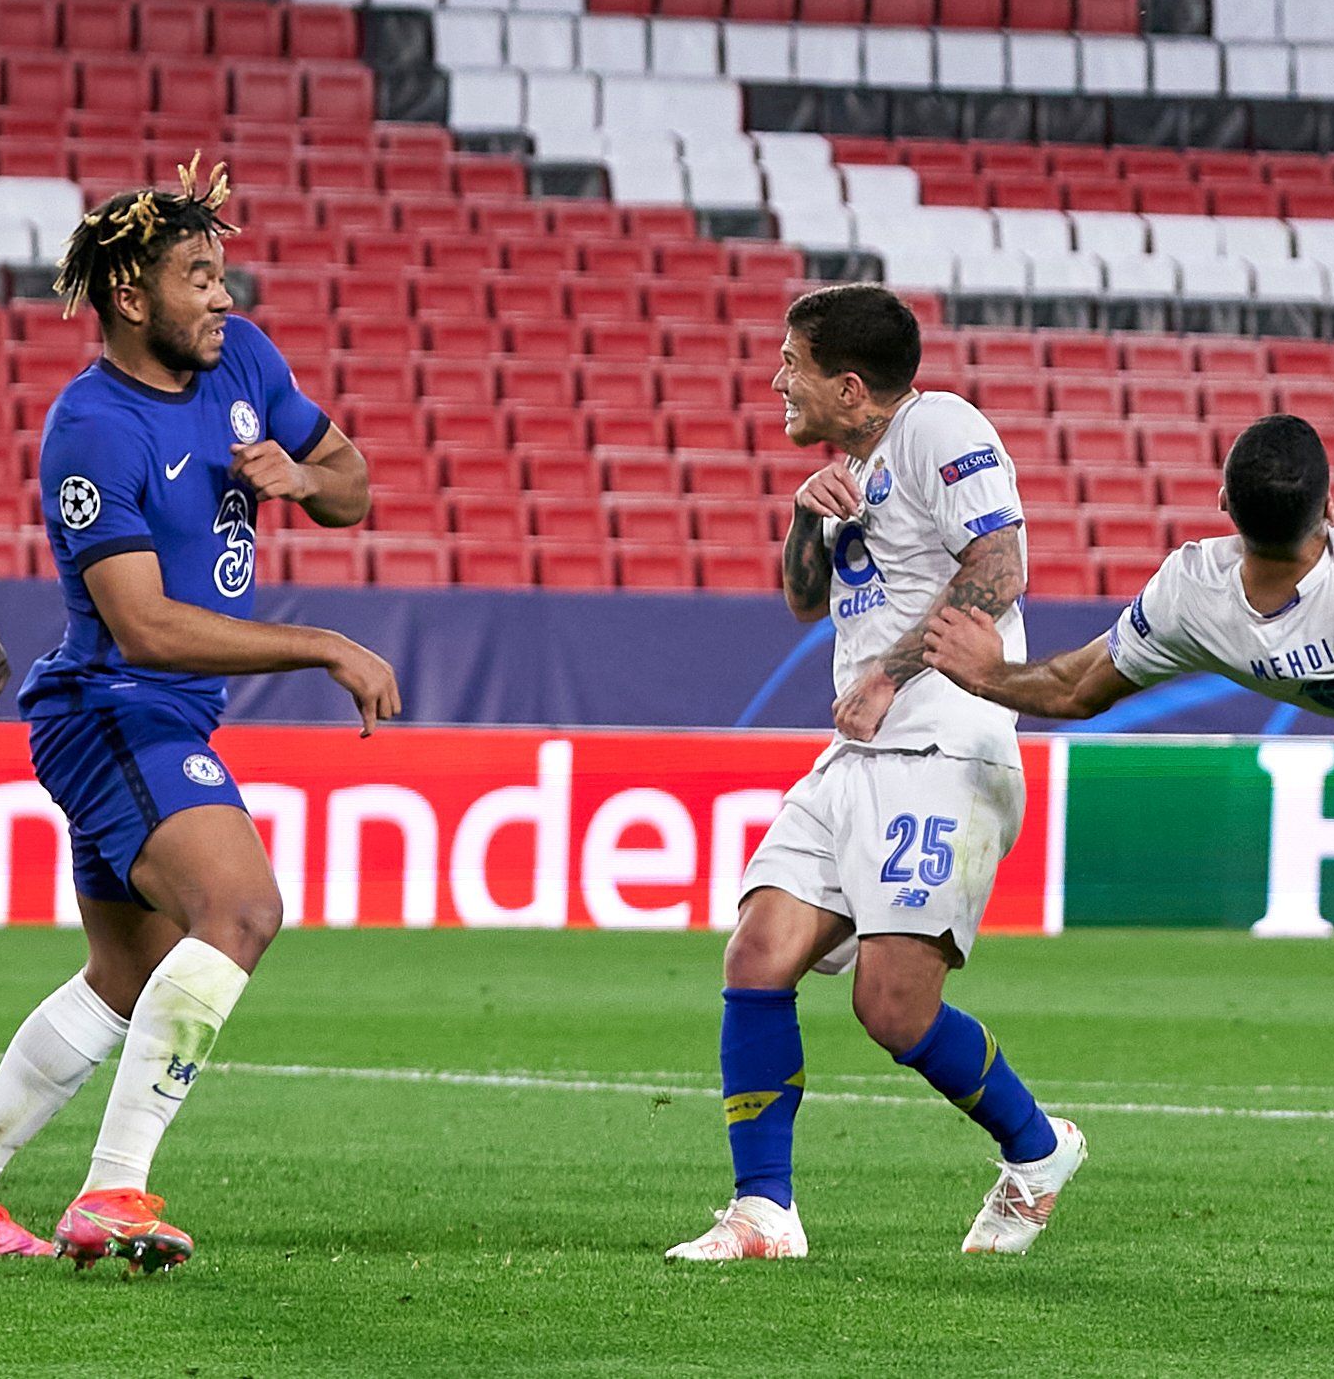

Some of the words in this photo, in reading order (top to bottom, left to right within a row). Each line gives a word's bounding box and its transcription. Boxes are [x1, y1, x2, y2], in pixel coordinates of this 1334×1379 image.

[957, 452, 996, 473] RESPECT
[1250, 638, 1334, 681] MEHDI
[880, 812, 958, 887] 25
